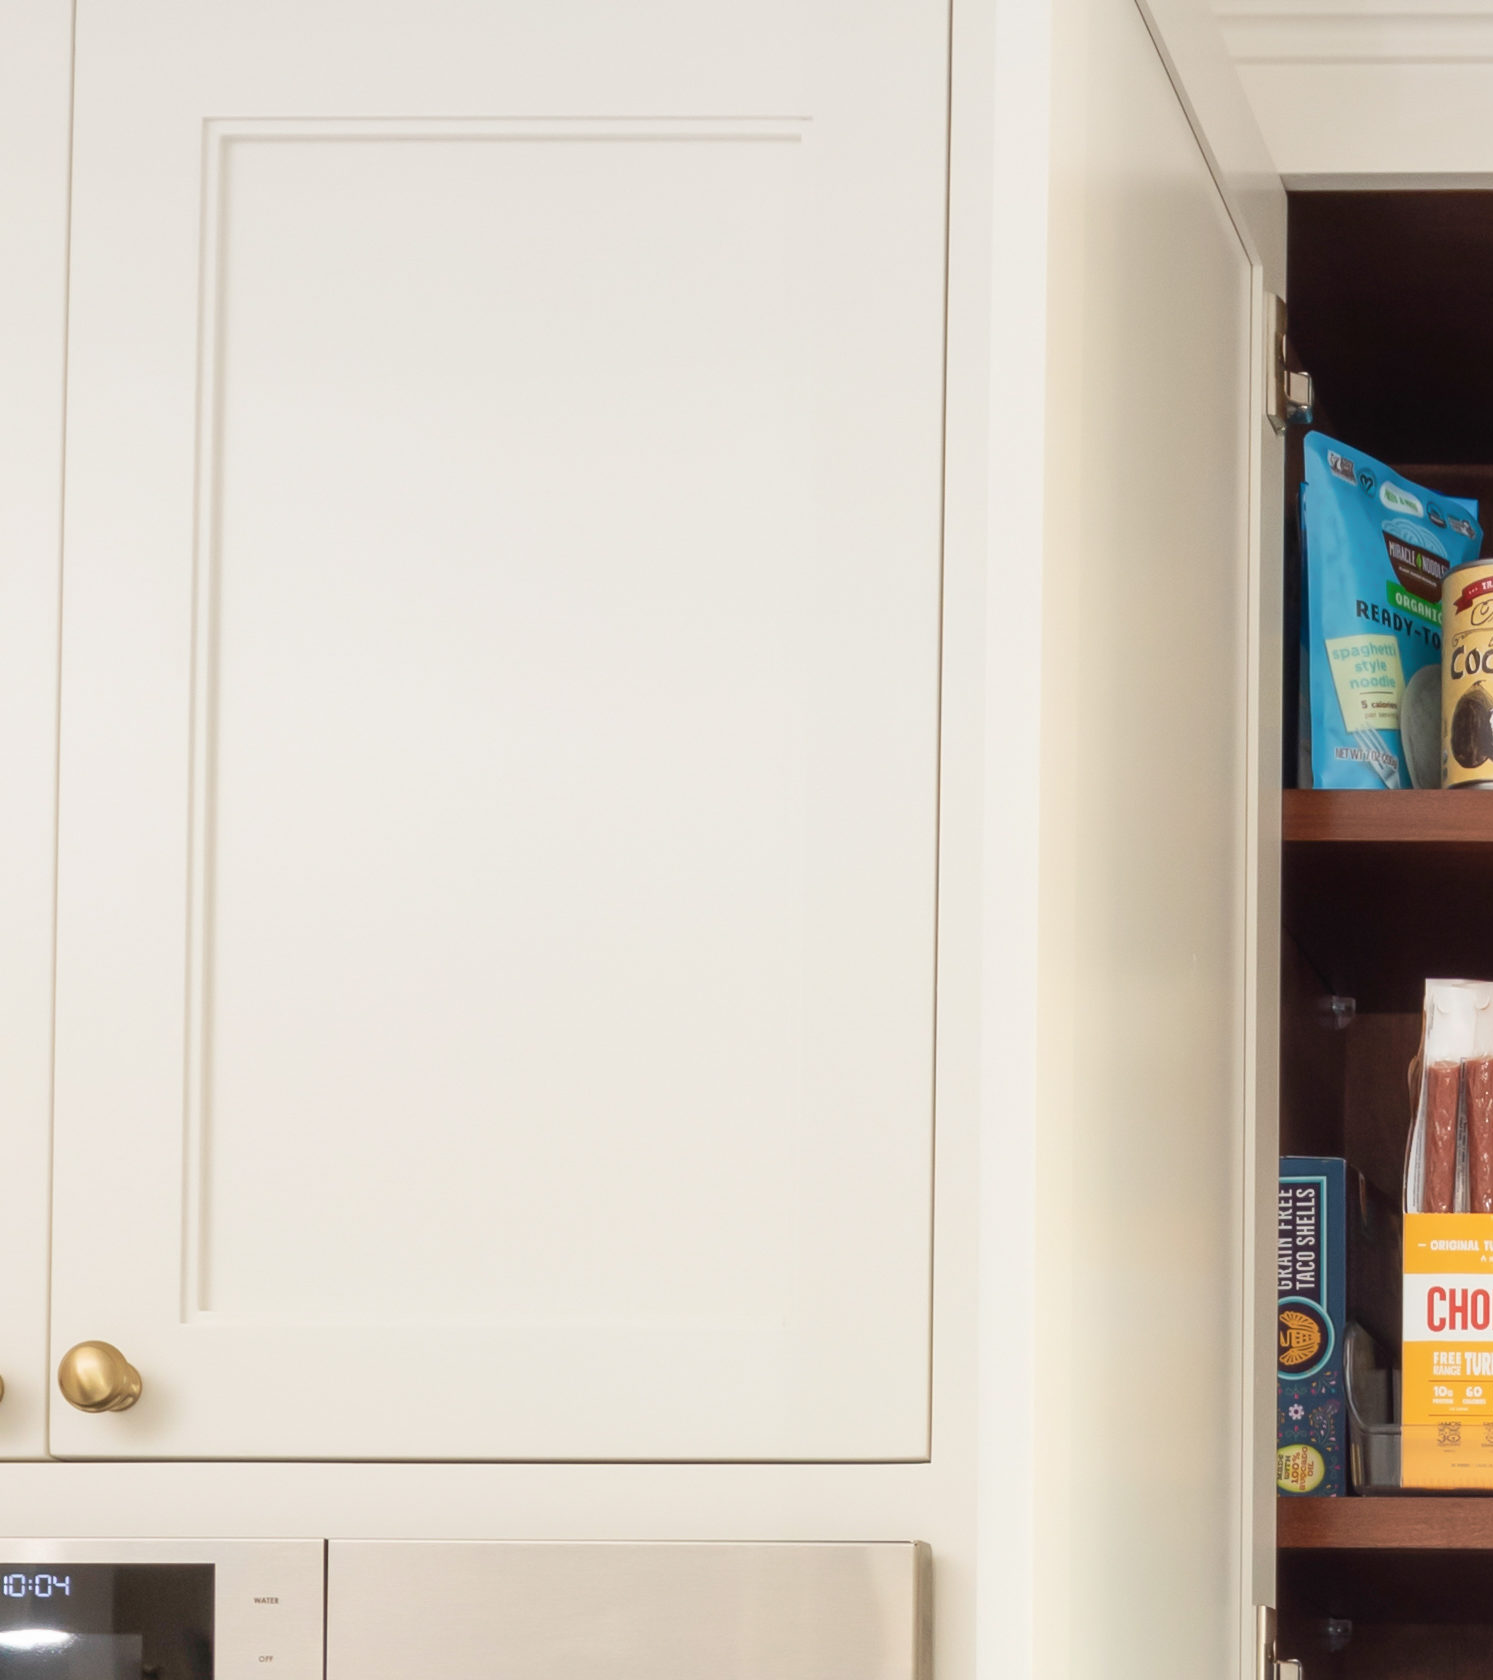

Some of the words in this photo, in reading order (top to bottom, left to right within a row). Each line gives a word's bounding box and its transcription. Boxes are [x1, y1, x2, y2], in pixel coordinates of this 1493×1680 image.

[1388, 539, 1416, 567] MIRACLE
[1395, 592, 1443, 624] ORGANIC
[1332, 643, 1397, 662] spaghetti
[1354, 660, 1387, 674] style
[1350, 676, 1397, 690] noodle
[1361, 700, 1368, 709] 5
[1296, 1188, 1315, 1246] SHELLS
[1430, 1240, 1480, 1251] ORIGINAL
[1296, 1251, 1315, 1291] TACO
[1433, 1352, 1462, 1365] FREE
[1465, 1386, 1483, 1398] 60
[3, 1574, 71, 1598] 10:04
[258, 1655, 274, 1663] OFF
